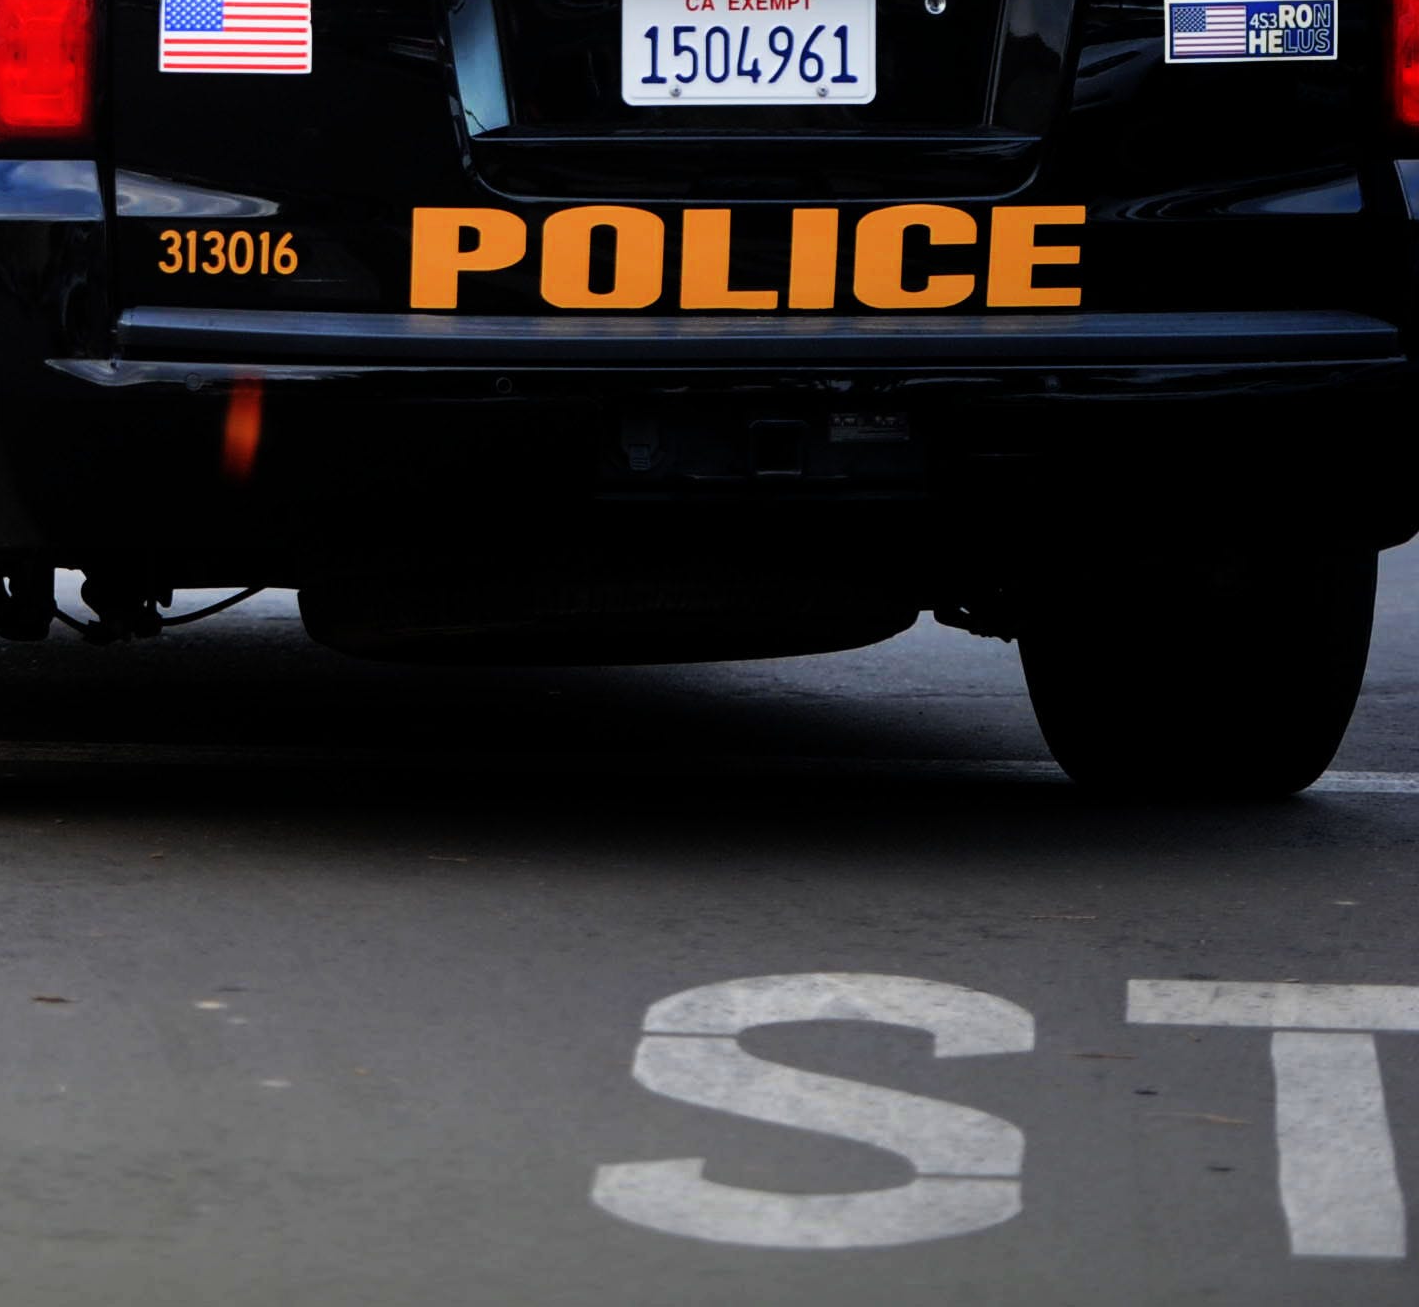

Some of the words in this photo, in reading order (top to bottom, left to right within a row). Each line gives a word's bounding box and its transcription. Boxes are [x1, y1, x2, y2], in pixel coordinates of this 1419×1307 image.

[641, 24, 859, 84] 1504961
[1249, 29, 1331, 54] HELUS
[158, 230, 298, 275] 313016
[410, 205, 1086, 309] POLICE
